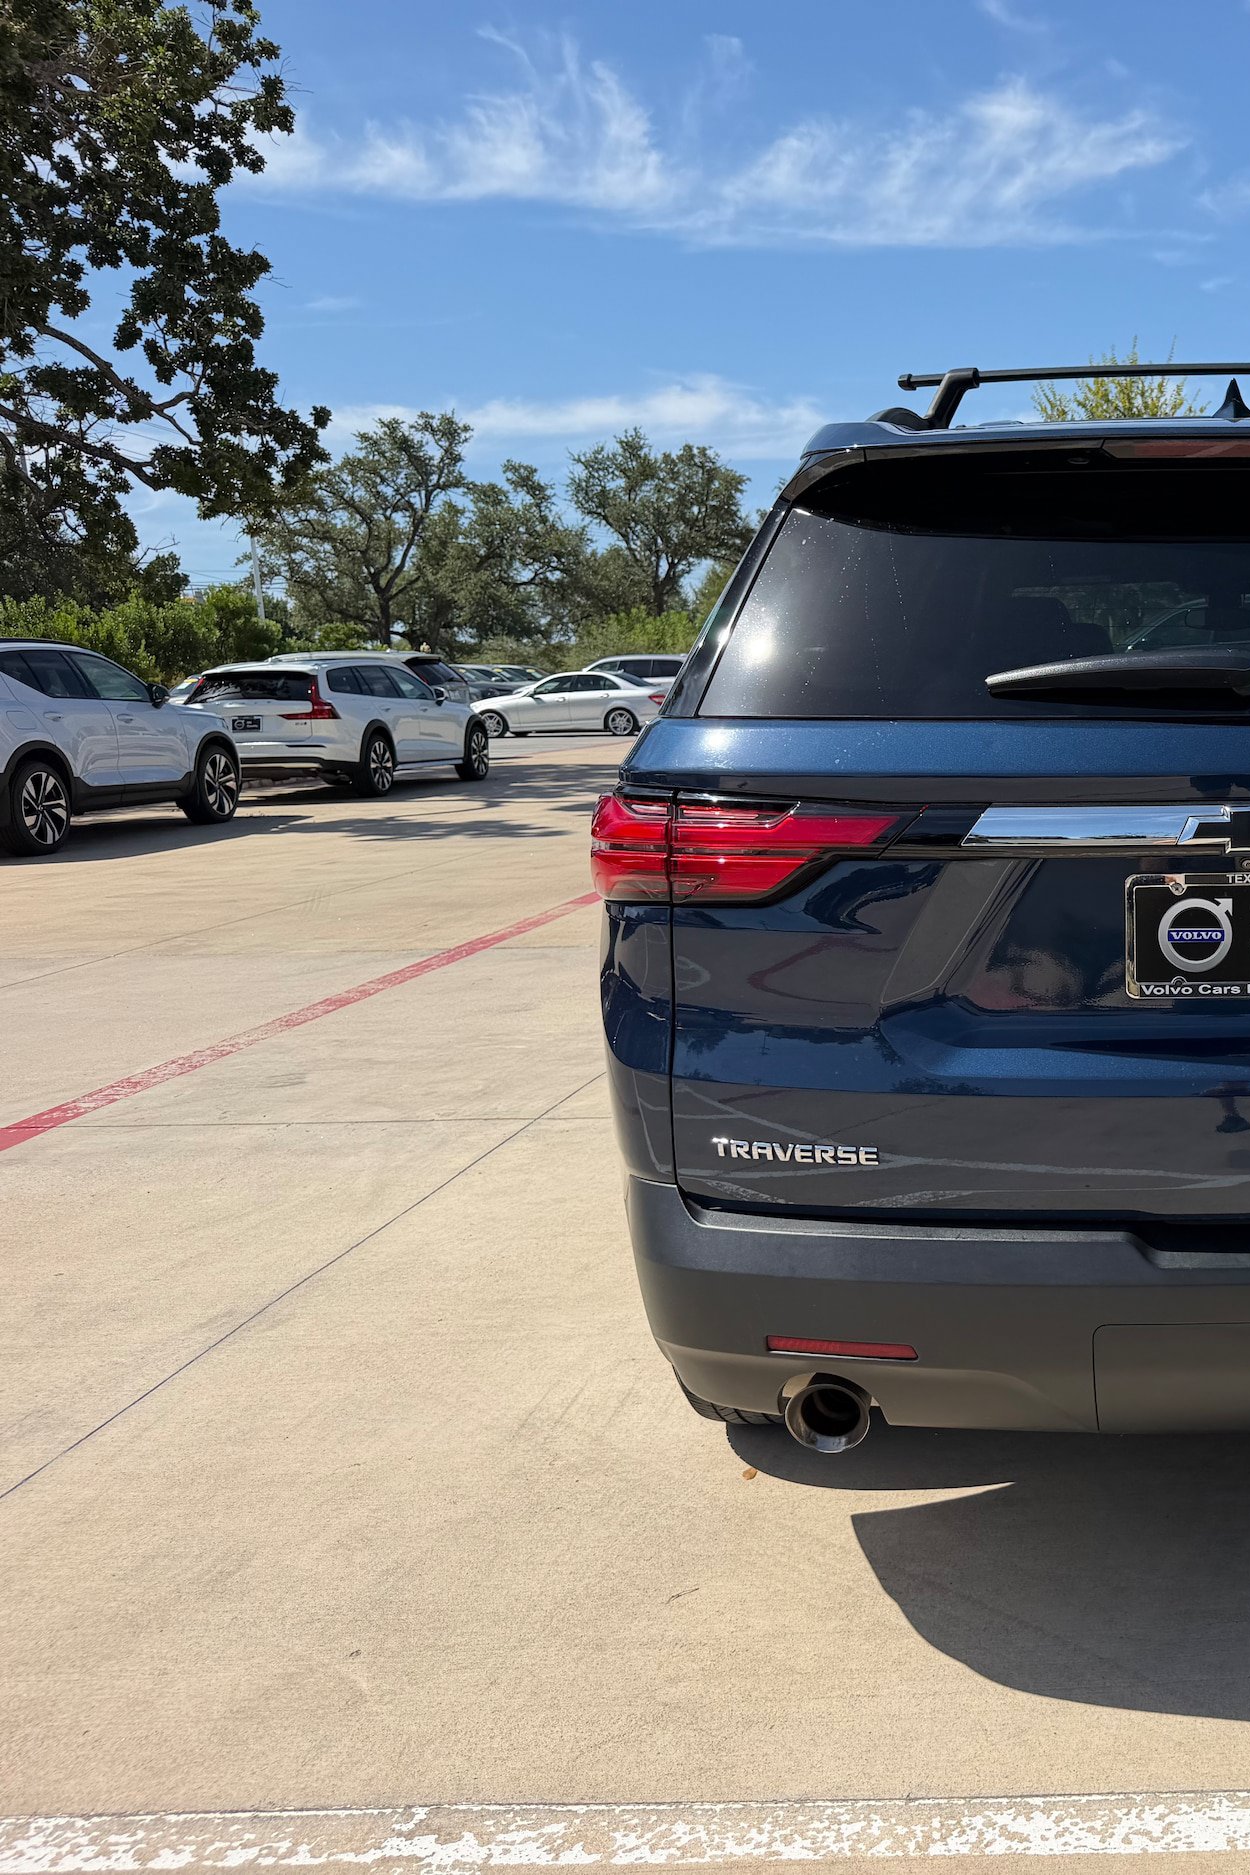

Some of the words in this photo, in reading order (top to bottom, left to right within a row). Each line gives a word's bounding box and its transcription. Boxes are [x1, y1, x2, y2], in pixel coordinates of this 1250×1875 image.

[1170, 931, 1223, 941] VOLVO
[1141, 984, 1193, 996] Volvo
[1198, 984, 1241, 995] Cars
[711, 1137, 879, 1166] TRAVERSE
